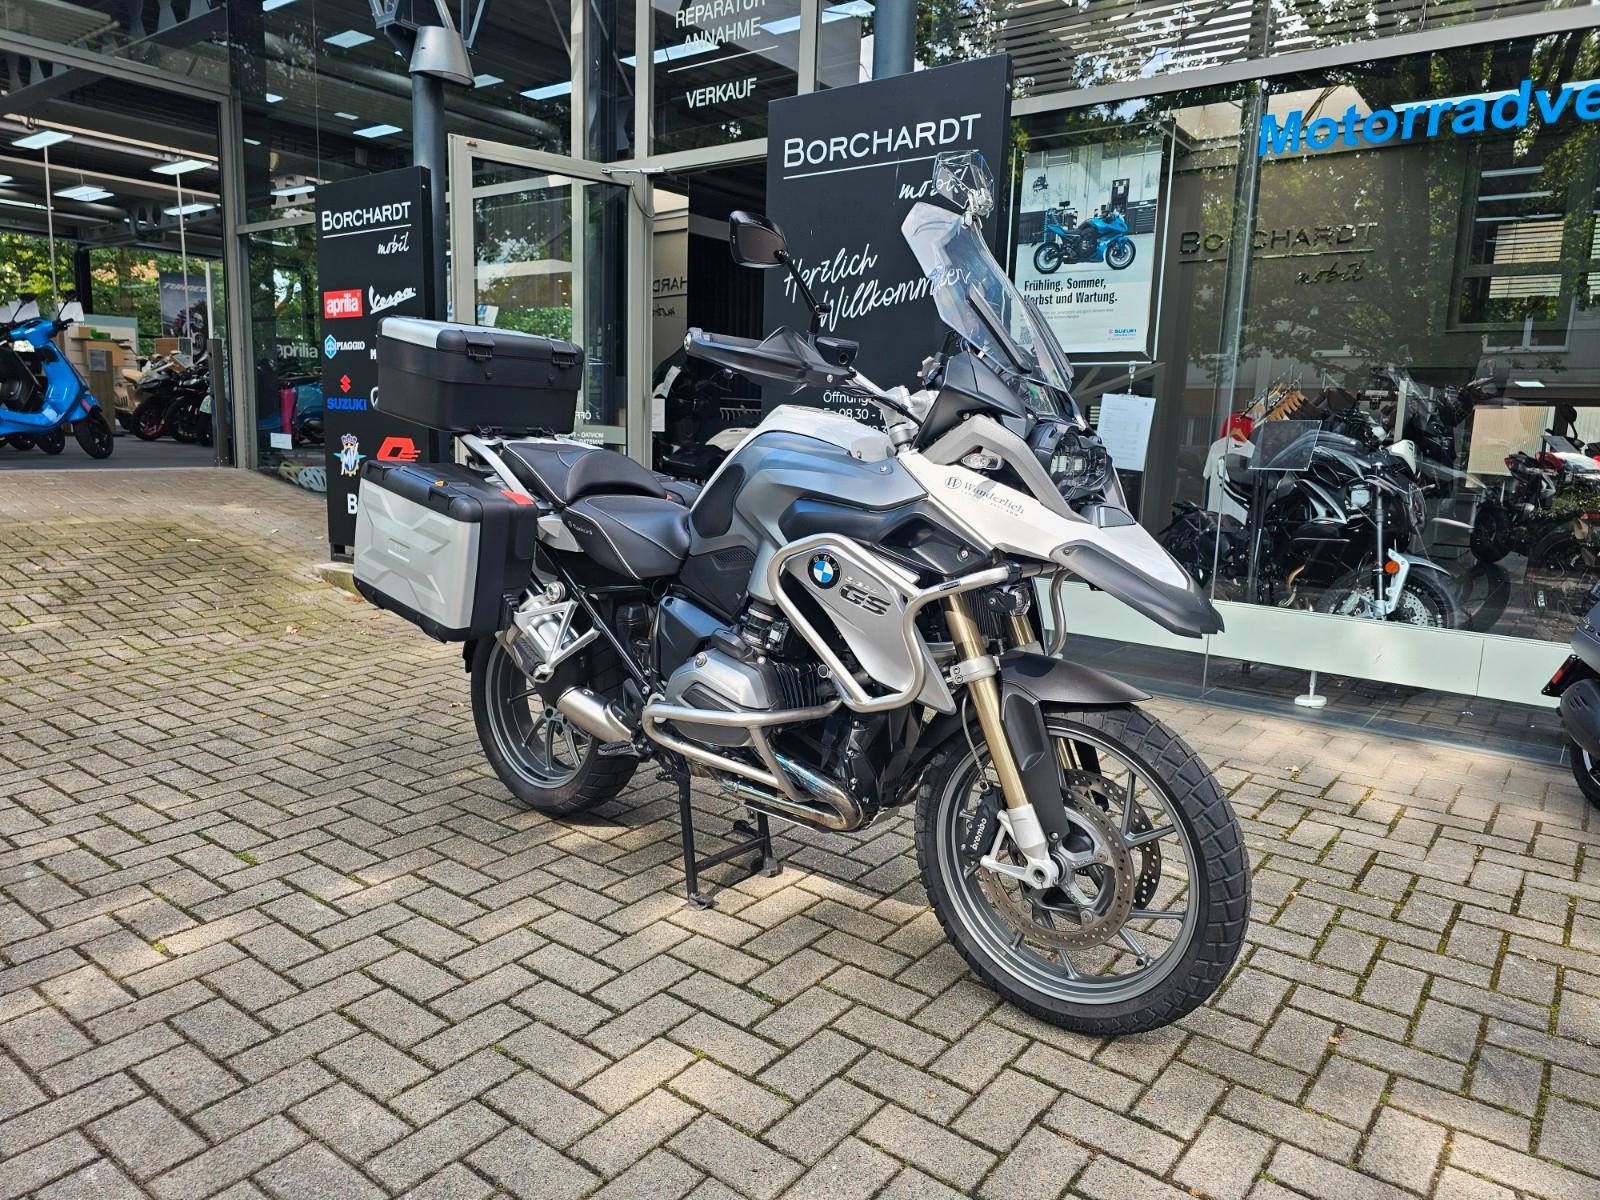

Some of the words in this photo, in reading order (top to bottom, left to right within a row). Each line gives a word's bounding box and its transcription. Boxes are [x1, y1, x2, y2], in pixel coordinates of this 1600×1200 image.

[684, 16, 761, 50] ANNAHME
[686, 77, 758, 109] VERKAUF
[783, 113, 982, 169] BORCHARDT
[321, 201, 412, 231] BORCHARDT
[377, 231, 410, 255] mobil
[1180, 222, 1379, 255] BOCHARDT
[783, 243, 878, 304] Herzlich
[1024, 279, 1064, 292] Frühling,
[1066, 278, 1107, 290] Sommer,
[326, 293, 359, 316] aprilia
[368, 285, 416, 314] Vespa
[1055, 292, 1073, 304] und
[1075, 291, 1118, 305] Wartung.
[336, 341, 366, 351] PIAGGIO
[326, 397, 368, 411] SUZUKI
[840, 584, 892, 616] GS
[970, 818, 987, 850] brembo
